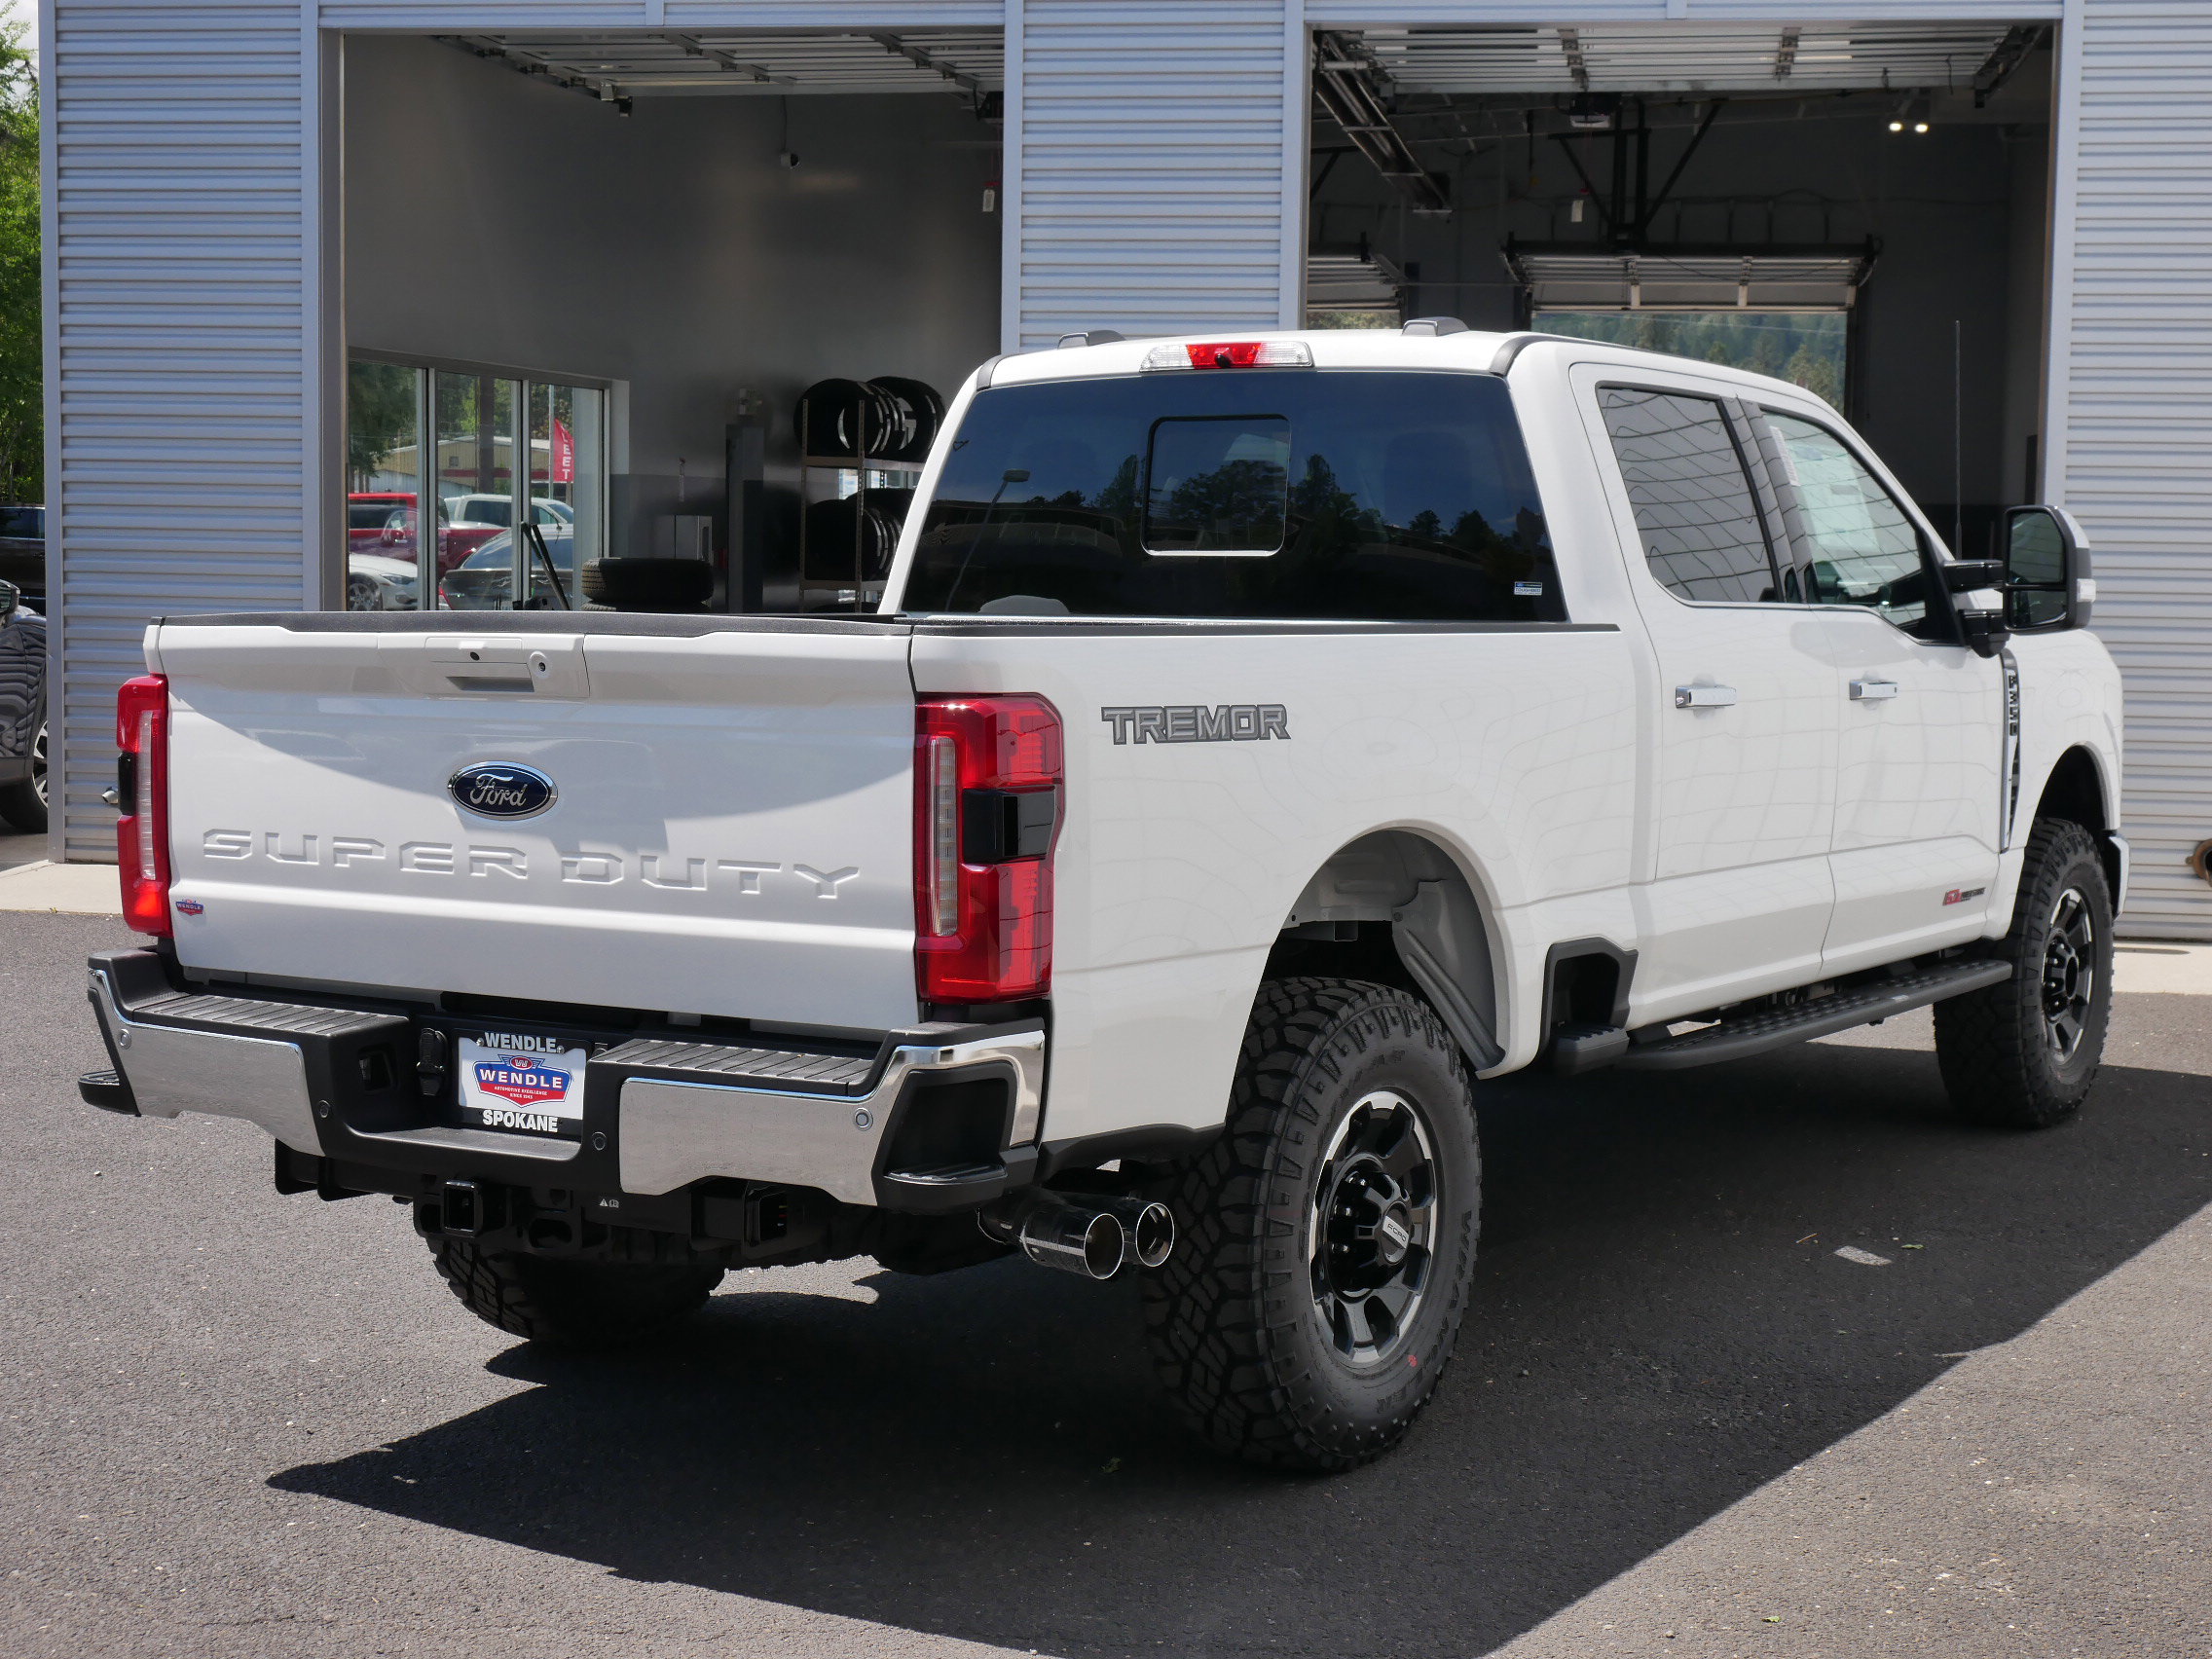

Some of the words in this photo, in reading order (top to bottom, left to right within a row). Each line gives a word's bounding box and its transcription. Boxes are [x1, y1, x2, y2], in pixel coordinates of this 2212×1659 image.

[1101, 703, 1292, 745] TREMOR
[469, 773, 528, 807] Ford
[203, 828, 530, 880] SUPER
[561, 850, 861, 900] DUTY
[484, 1032, 560, 1054] WENDLE
[479, 1069, 564, 1088] WENDLE
[482, 1109, 559, 1133] SPOKANE
